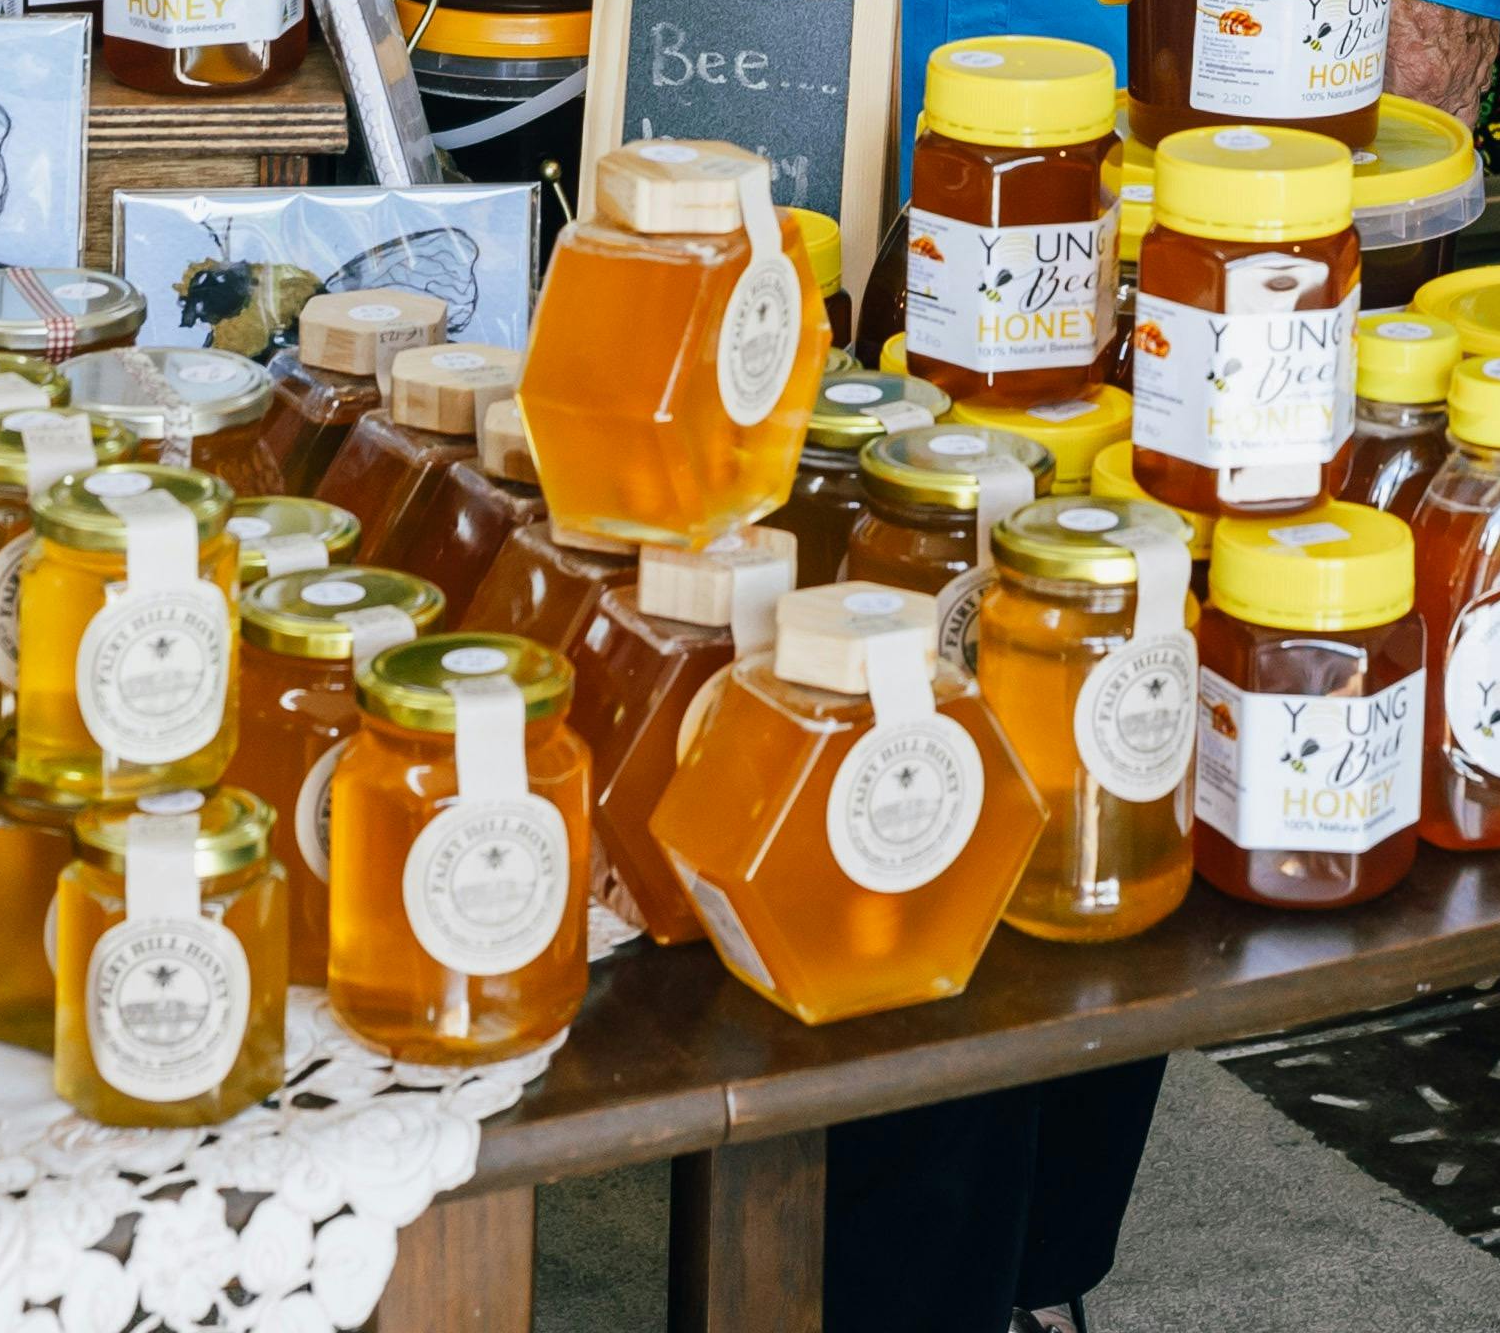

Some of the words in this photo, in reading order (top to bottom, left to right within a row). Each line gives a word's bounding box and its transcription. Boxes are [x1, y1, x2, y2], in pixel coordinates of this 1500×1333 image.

[176, 21, 236, 34] Beekeepers
[1334, 12, 1388, 60] Bees
[1308, 54, 1382, 89] HONEY
[1301, 92, 1325, 102] 100%
[1327, 88, 1353, 101] Natural
[978, 309, 1097, 343] HONEY
[131, 608, 176, 631] HILL
[1132, 649, 1169, 672] HILL
[880, 737, 919, 763] HILL
[1283, 775, 1395, 819] HONEY
[130, 936, 178, 957] HILL
[185, 941, 229, 1000] HONEY
